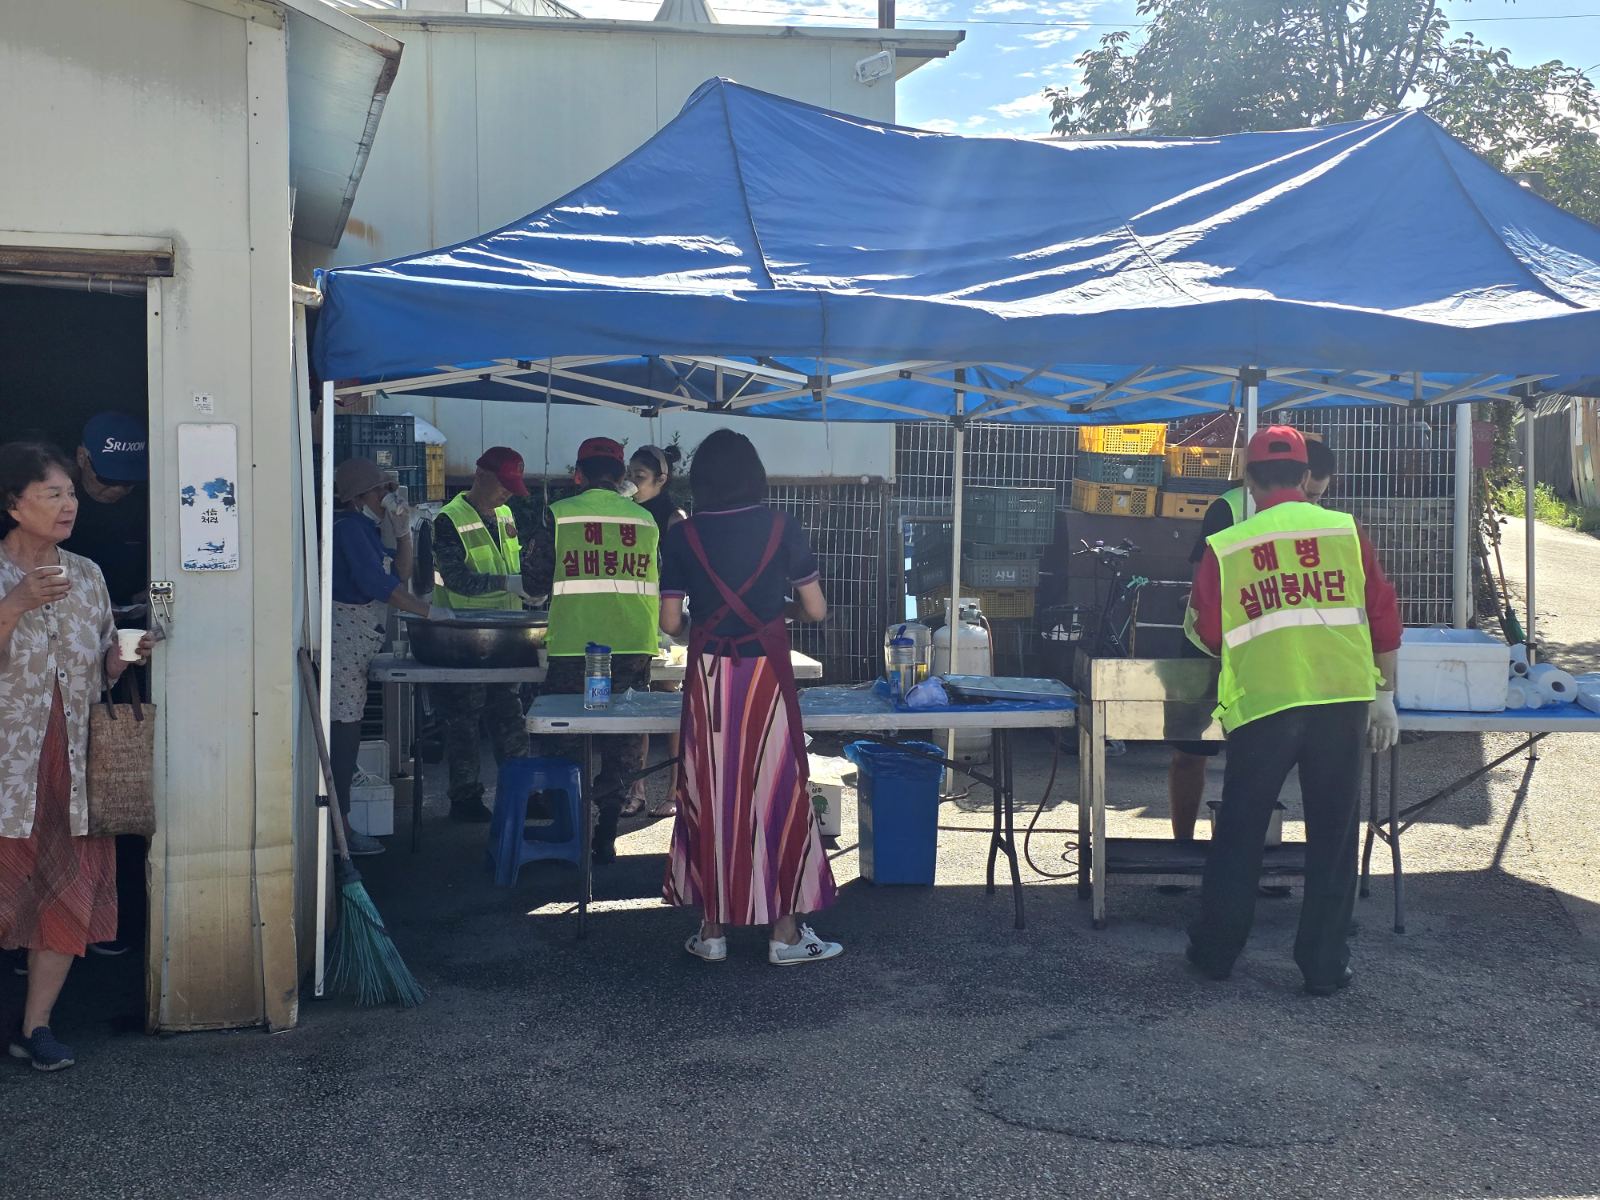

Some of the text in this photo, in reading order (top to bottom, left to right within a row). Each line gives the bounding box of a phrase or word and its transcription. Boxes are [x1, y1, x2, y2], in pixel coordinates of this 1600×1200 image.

[102, 437, 146, 453] SRIXON
[562, 549, 651, 578] 실버봉사단
[1239, 569, 1345, 620] 실버봉사단
